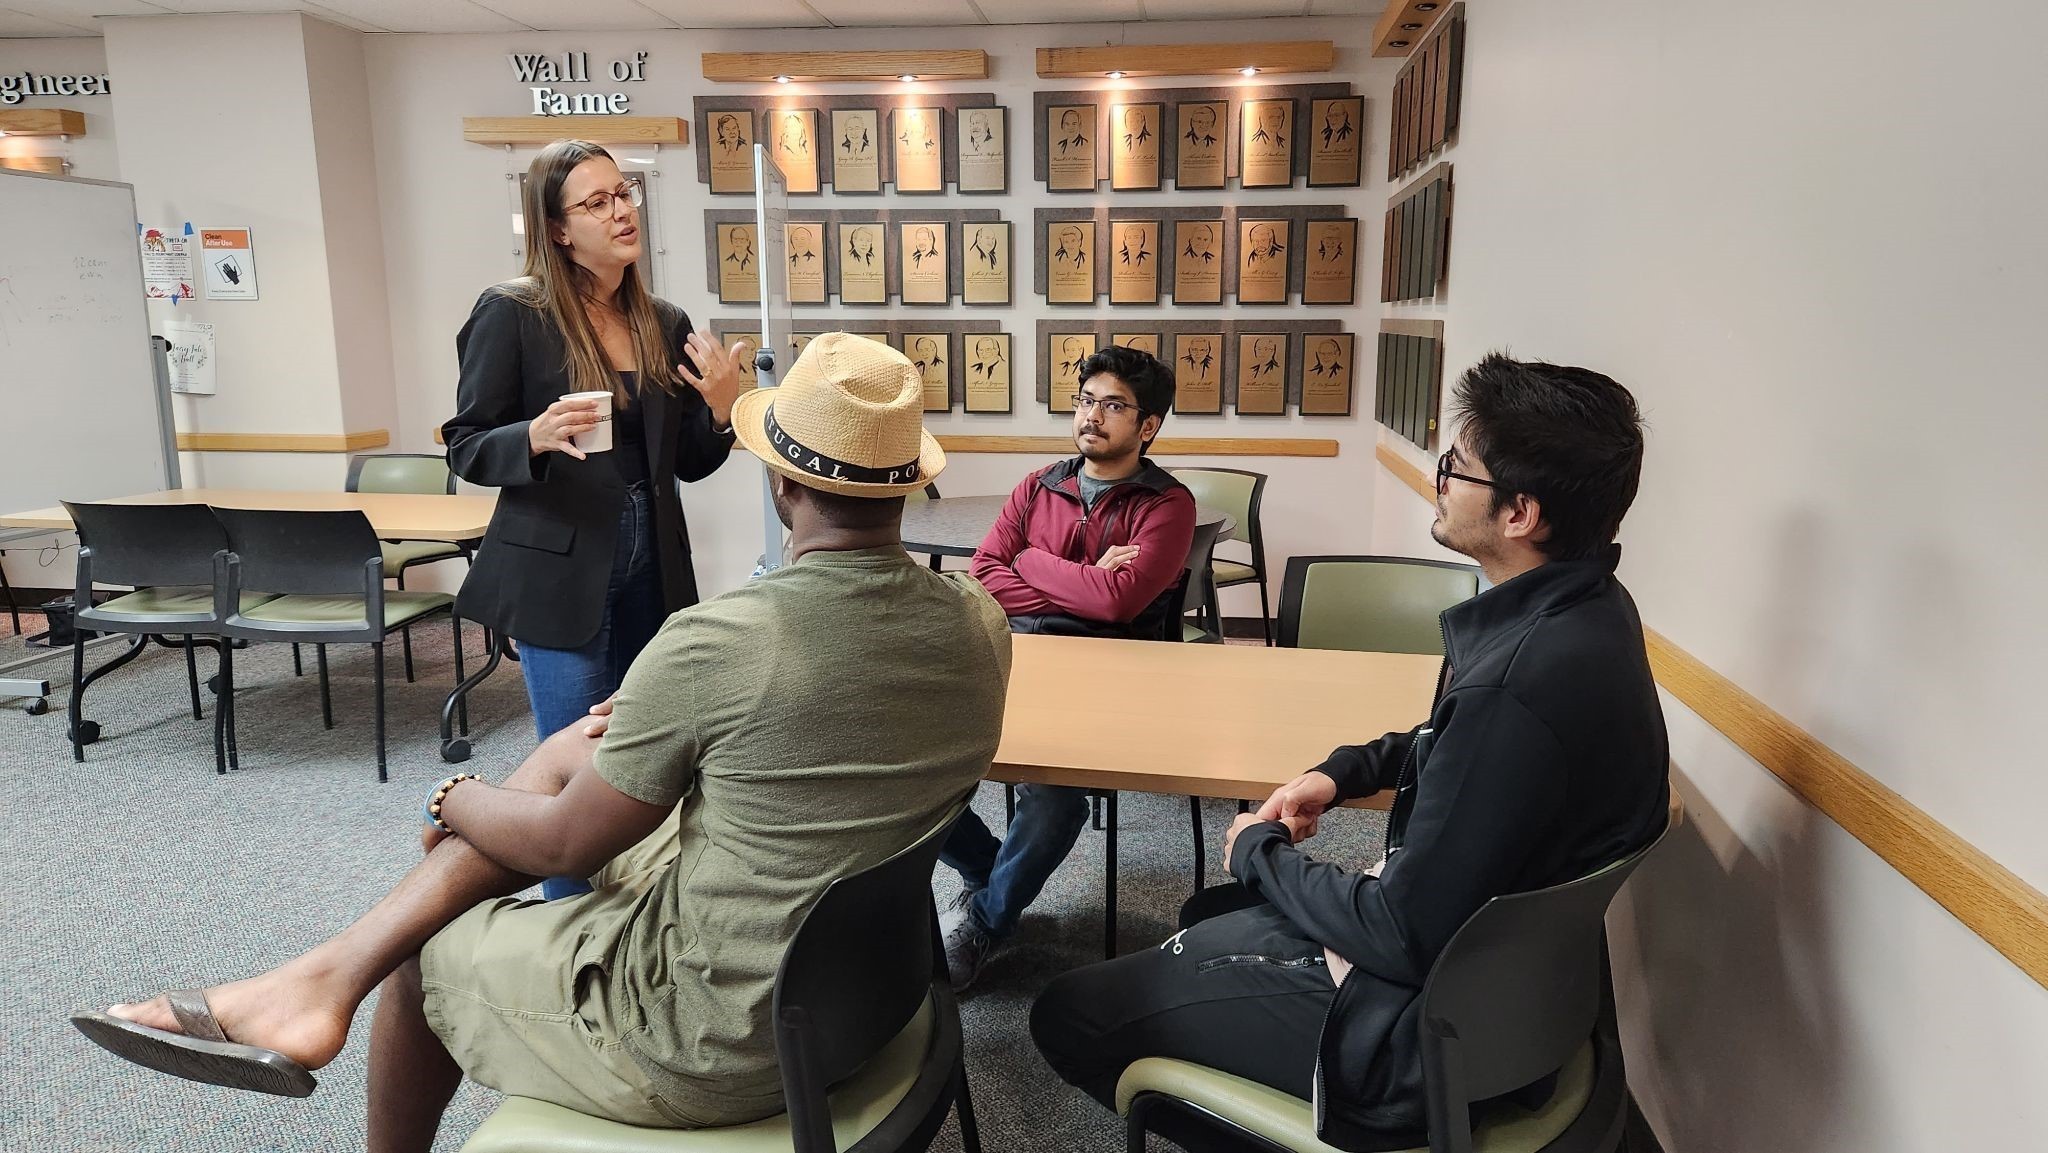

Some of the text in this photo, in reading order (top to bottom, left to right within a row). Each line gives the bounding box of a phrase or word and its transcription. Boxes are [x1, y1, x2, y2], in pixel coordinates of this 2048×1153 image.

[506, 50, 648, 82] Wall of
[529, 86, 630, 116] Fame
[221, 239, 233, 247] Use
[888, 461, 920, 484] PO
